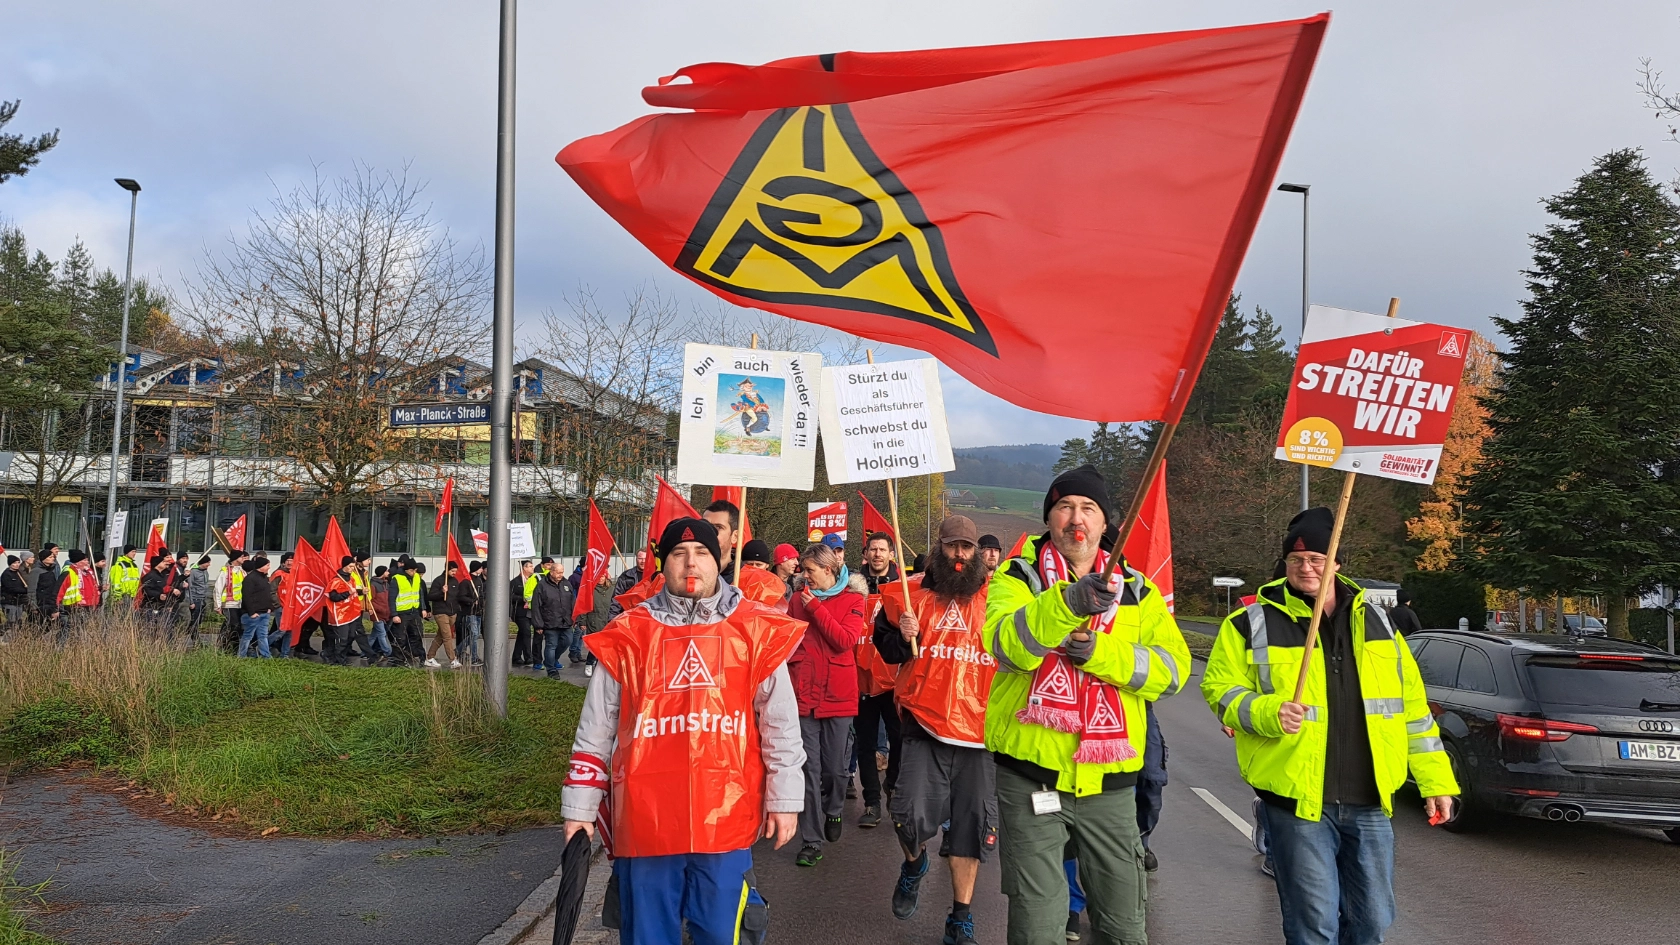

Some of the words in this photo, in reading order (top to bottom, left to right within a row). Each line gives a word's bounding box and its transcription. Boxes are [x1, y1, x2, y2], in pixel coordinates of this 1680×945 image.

[693, 356, 715, 377] bin
[734, 360, 769, 372] auch
[1346, 348, 1424, 379] DAFÜR
[790, 359, 811, 407] wieder
[848, 371, 889, 385] Stürzt
[891, 370, 908, 381] du
[872, 389, 889, 399] als
[1297, 362, 1454, 413] STREITEN
[395, 405, 486, 421] Max-Planck-Straße
[690, 397, 704, 419] Ich
[840, 401, 924, 416] Geschäftsführer
[796, 412, 808, 429] da
[1353, 400, 1422, 438] WIR
[844, 420, 909, 437] schwebst
[911, 419, 928, 430] du
[872, 440, 884, 449] in
[886, 438, 905, 448] die
[856, 454, 919, 471] Holding
[1382, 453, 1426, 466] SOLIDARITÄT
[810, 517, 827, 527] FÜR
[1630, 744, 1648, 758] AM
